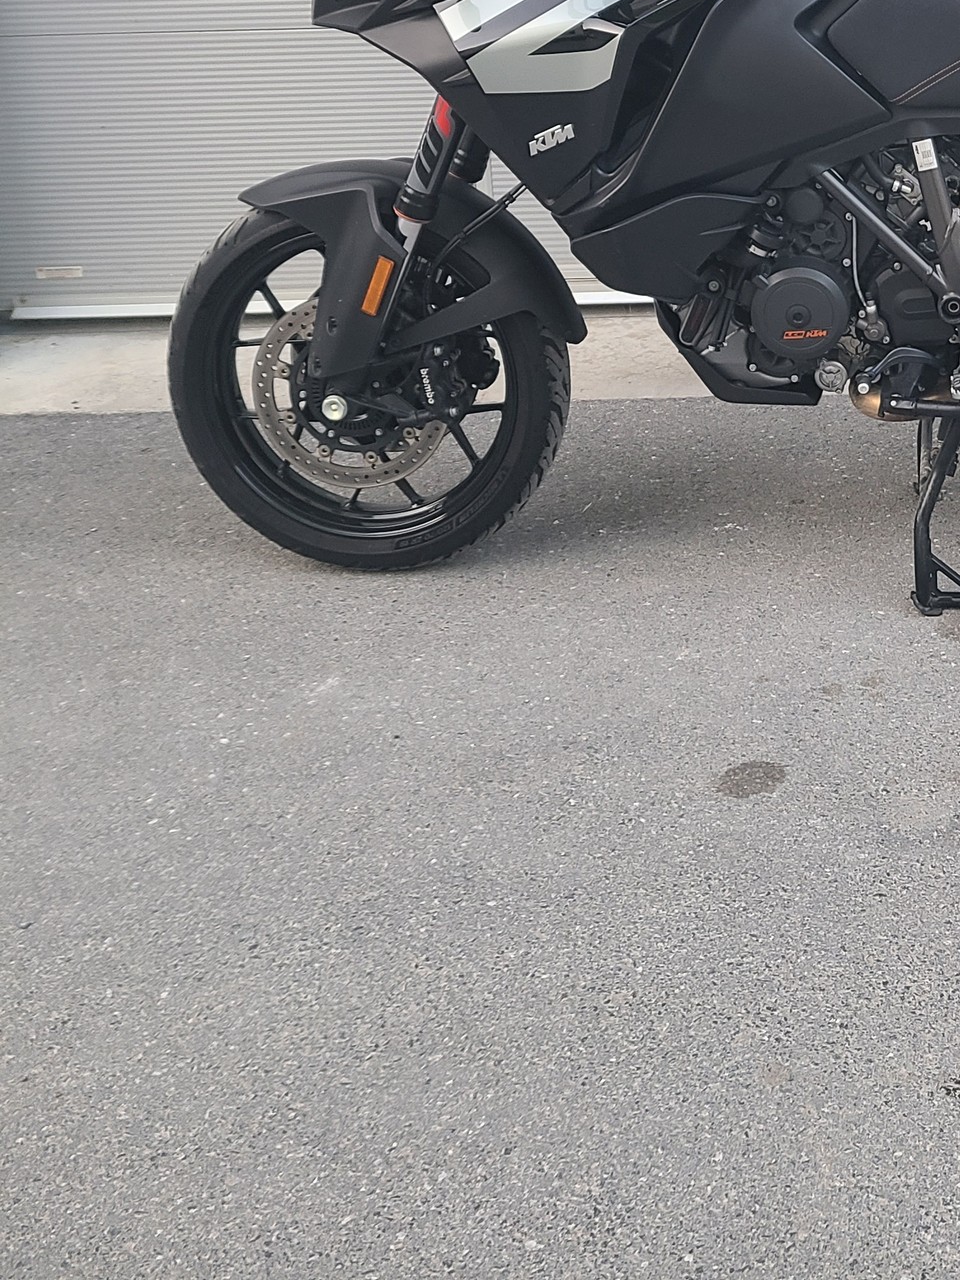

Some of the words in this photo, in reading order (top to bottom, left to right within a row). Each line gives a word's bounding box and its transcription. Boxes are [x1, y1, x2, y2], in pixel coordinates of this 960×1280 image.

[528, 123, 575, 157] KTM
[806, 329, 827, 338] KTM
[420, 367, 435, 405] brembo
